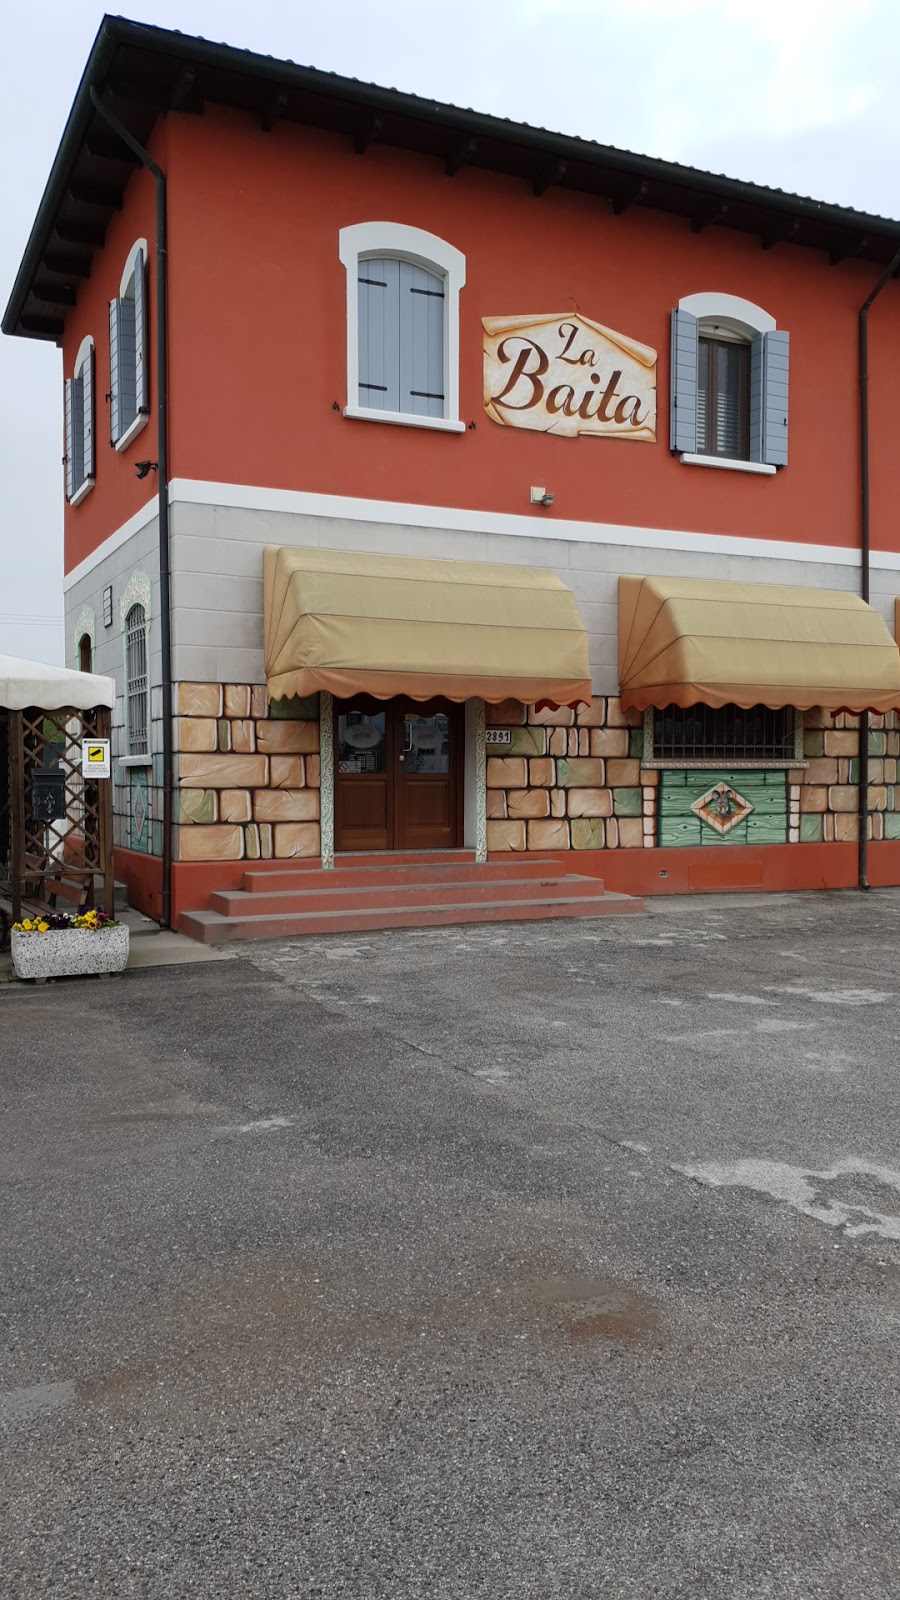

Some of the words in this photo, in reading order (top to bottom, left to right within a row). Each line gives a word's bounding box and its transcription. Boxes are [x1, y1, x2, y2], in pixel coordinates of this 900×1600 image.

[555, 322, 600, 367] La
[491, 336, 650, 426] Baita
[486, 731, 510, 742] 2891
